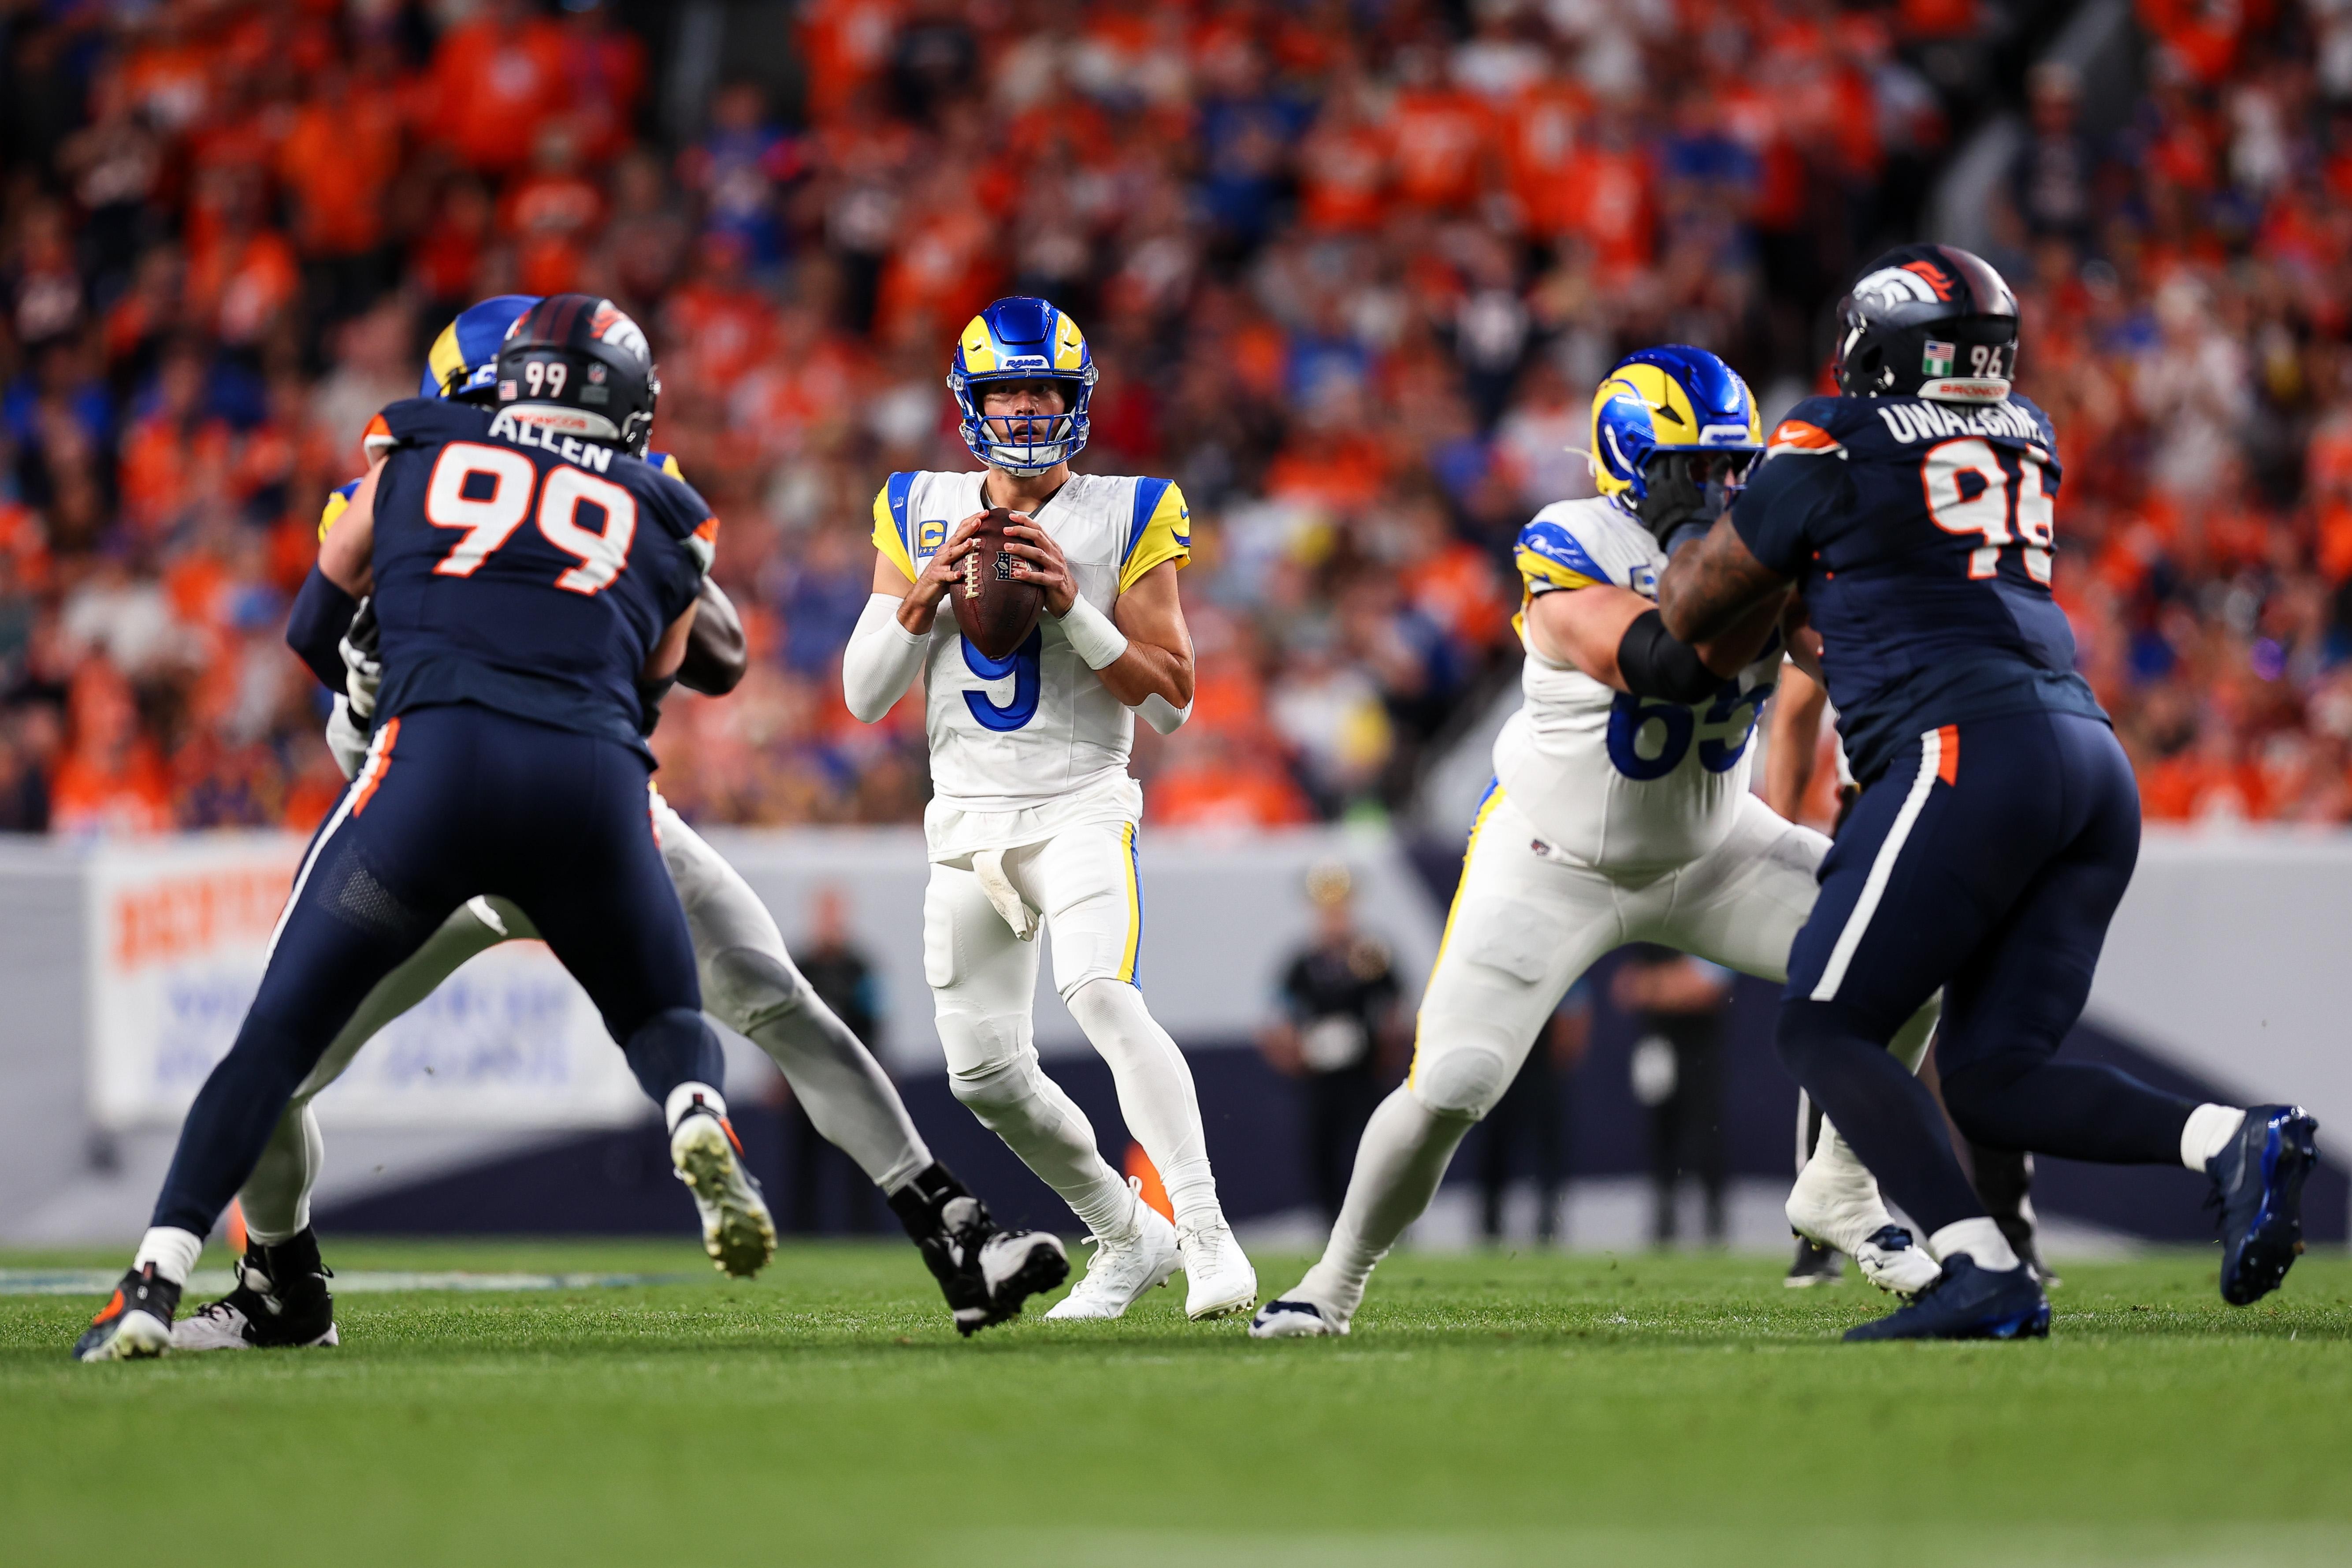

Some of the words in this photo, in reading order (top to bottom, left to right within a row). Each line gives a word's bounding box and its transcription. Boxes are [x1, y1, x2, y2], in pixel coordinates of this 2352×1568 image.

[525, 361, 568, 398] 99
[1006, 359, 1044, 368] RAMS
[1970, 345, 2003, 378] 96
[488, 415, 614, 473] ALLEN
[424, 441, 639, 596] 99
[920, 522, 944, 547] C
[1920, 435, 2054, 588] 96
[961, 623, 1042, 732] 9
[1606, 672, 1775, 780] 65
